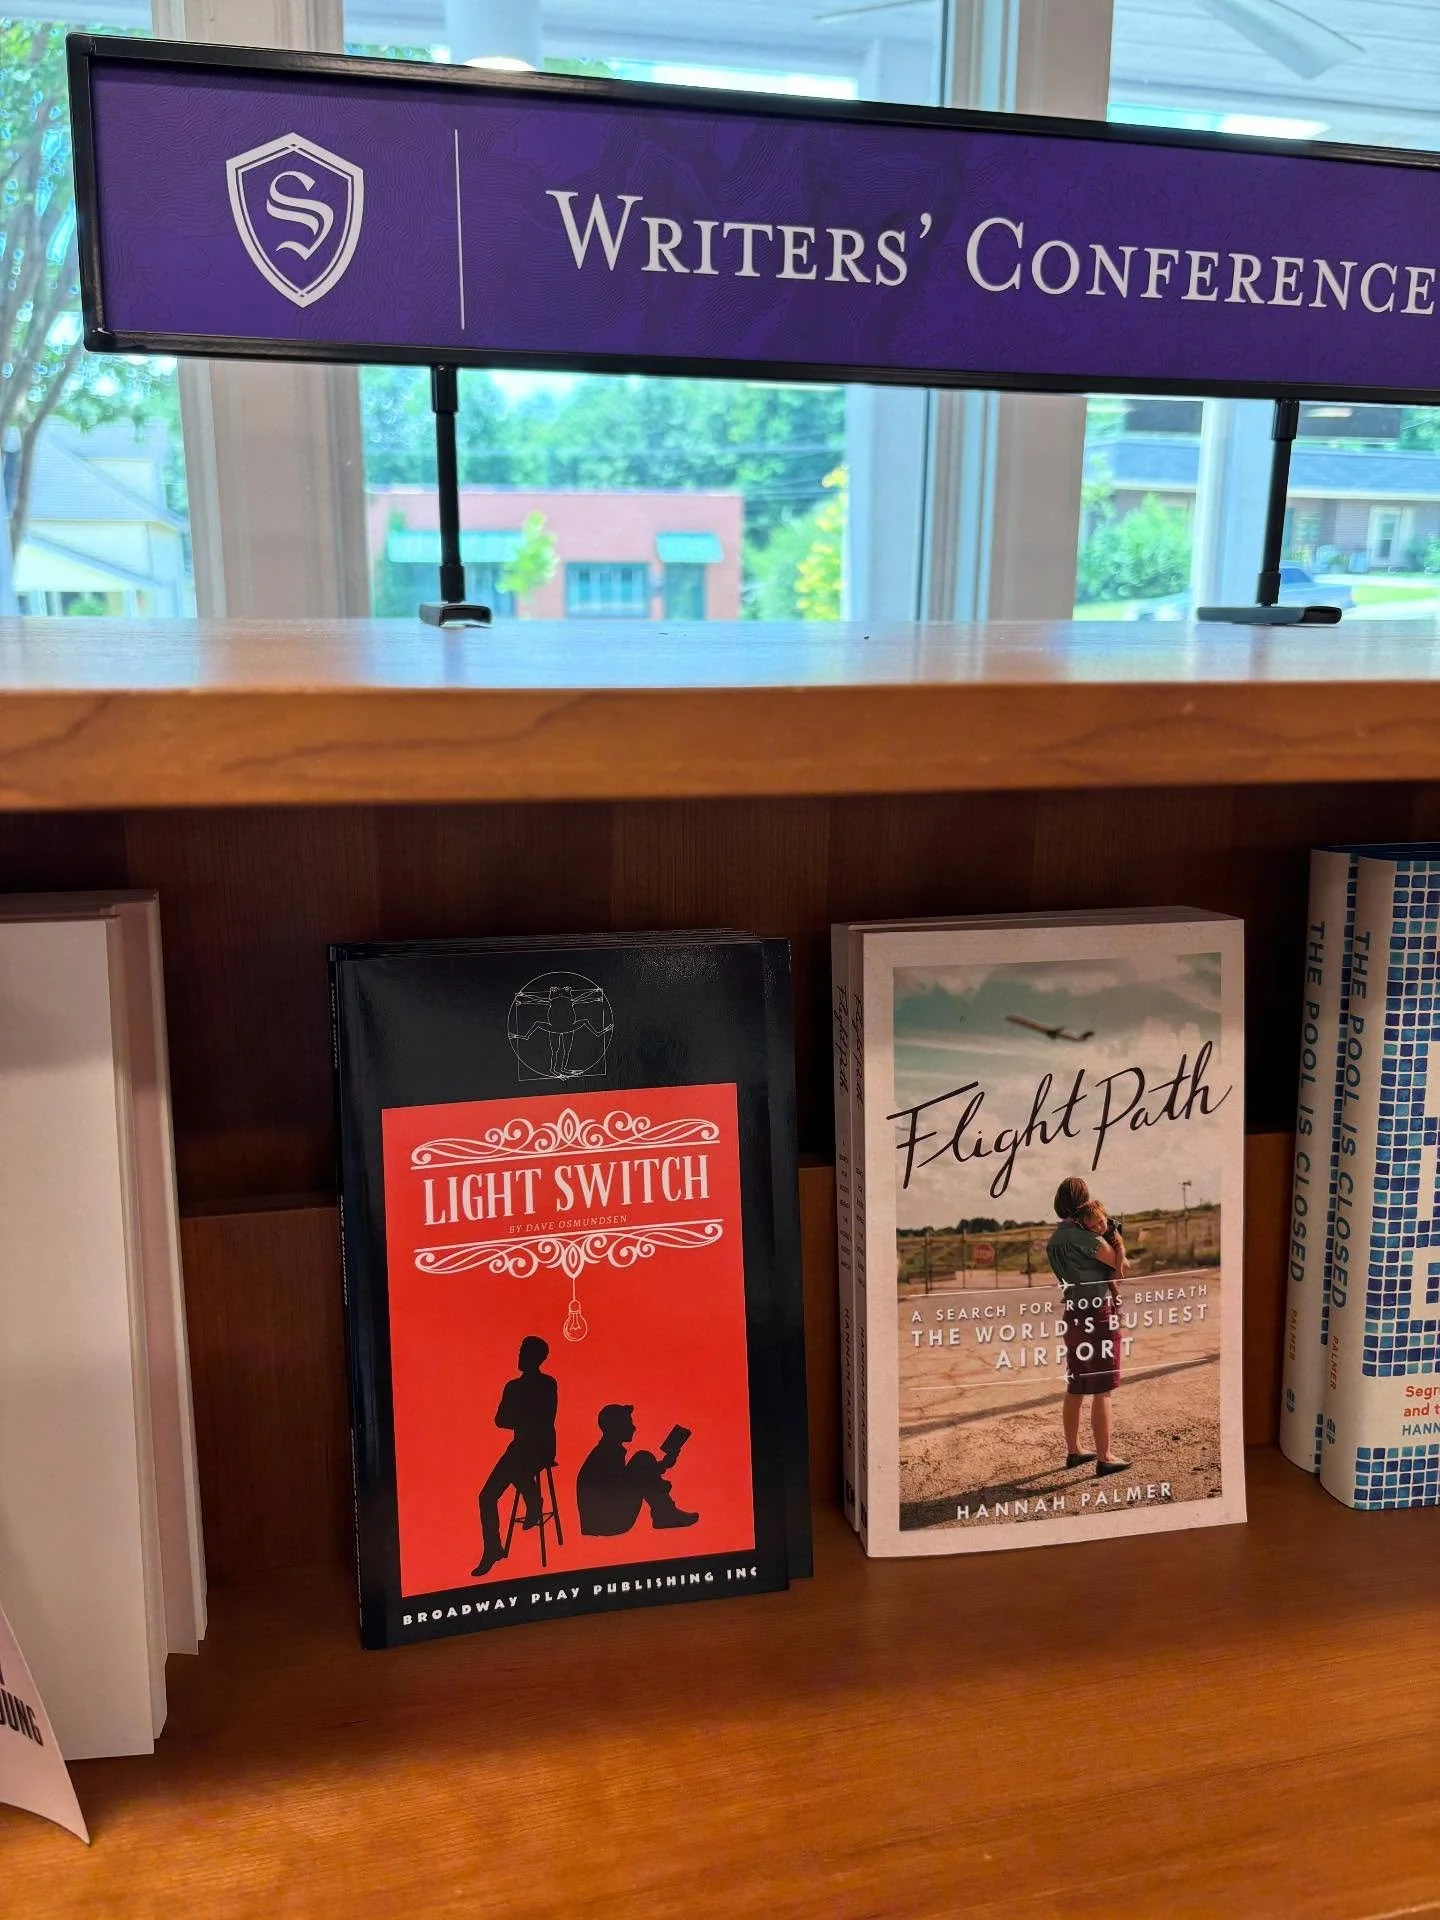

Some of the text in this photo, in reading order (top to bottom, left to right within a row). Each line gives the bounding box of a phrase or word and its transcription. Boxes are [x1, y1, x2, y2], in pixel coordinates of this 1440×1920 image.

[965, 216, 1436, 315] CONFERENCE
[885, 1040, 1233, 1200] Flight Path
[1290, 922, 1325, 1282] THE POOL IS CLOSED
[1331, 931, 1370, 1309] THE POOL IS CLOSED
[422, 1154, 711, 1226] LIGHT SWITCH
[508, 1214, 629, 1234] BY DAVE OSMUNDSEN
[911, 1284, 1208, 1323] A SEARCH FOR ROOTS BENEATH
[911, 1303, 1208, 1347] THE WORLD'S BUSIEST
[995, 1337, 1135, 1370] AIRPORT
[1288, 1308, 1298, 1362] PALMER
[1328, 1335, 1340, 1390] PALMER
[1403, 1402, 1430, 1417] and
[956, 1482, 1172, 1520] HANNAH PALMER
[402, 1566, 758, 1626] BROADWAY PLAY PUBLISHING INC
